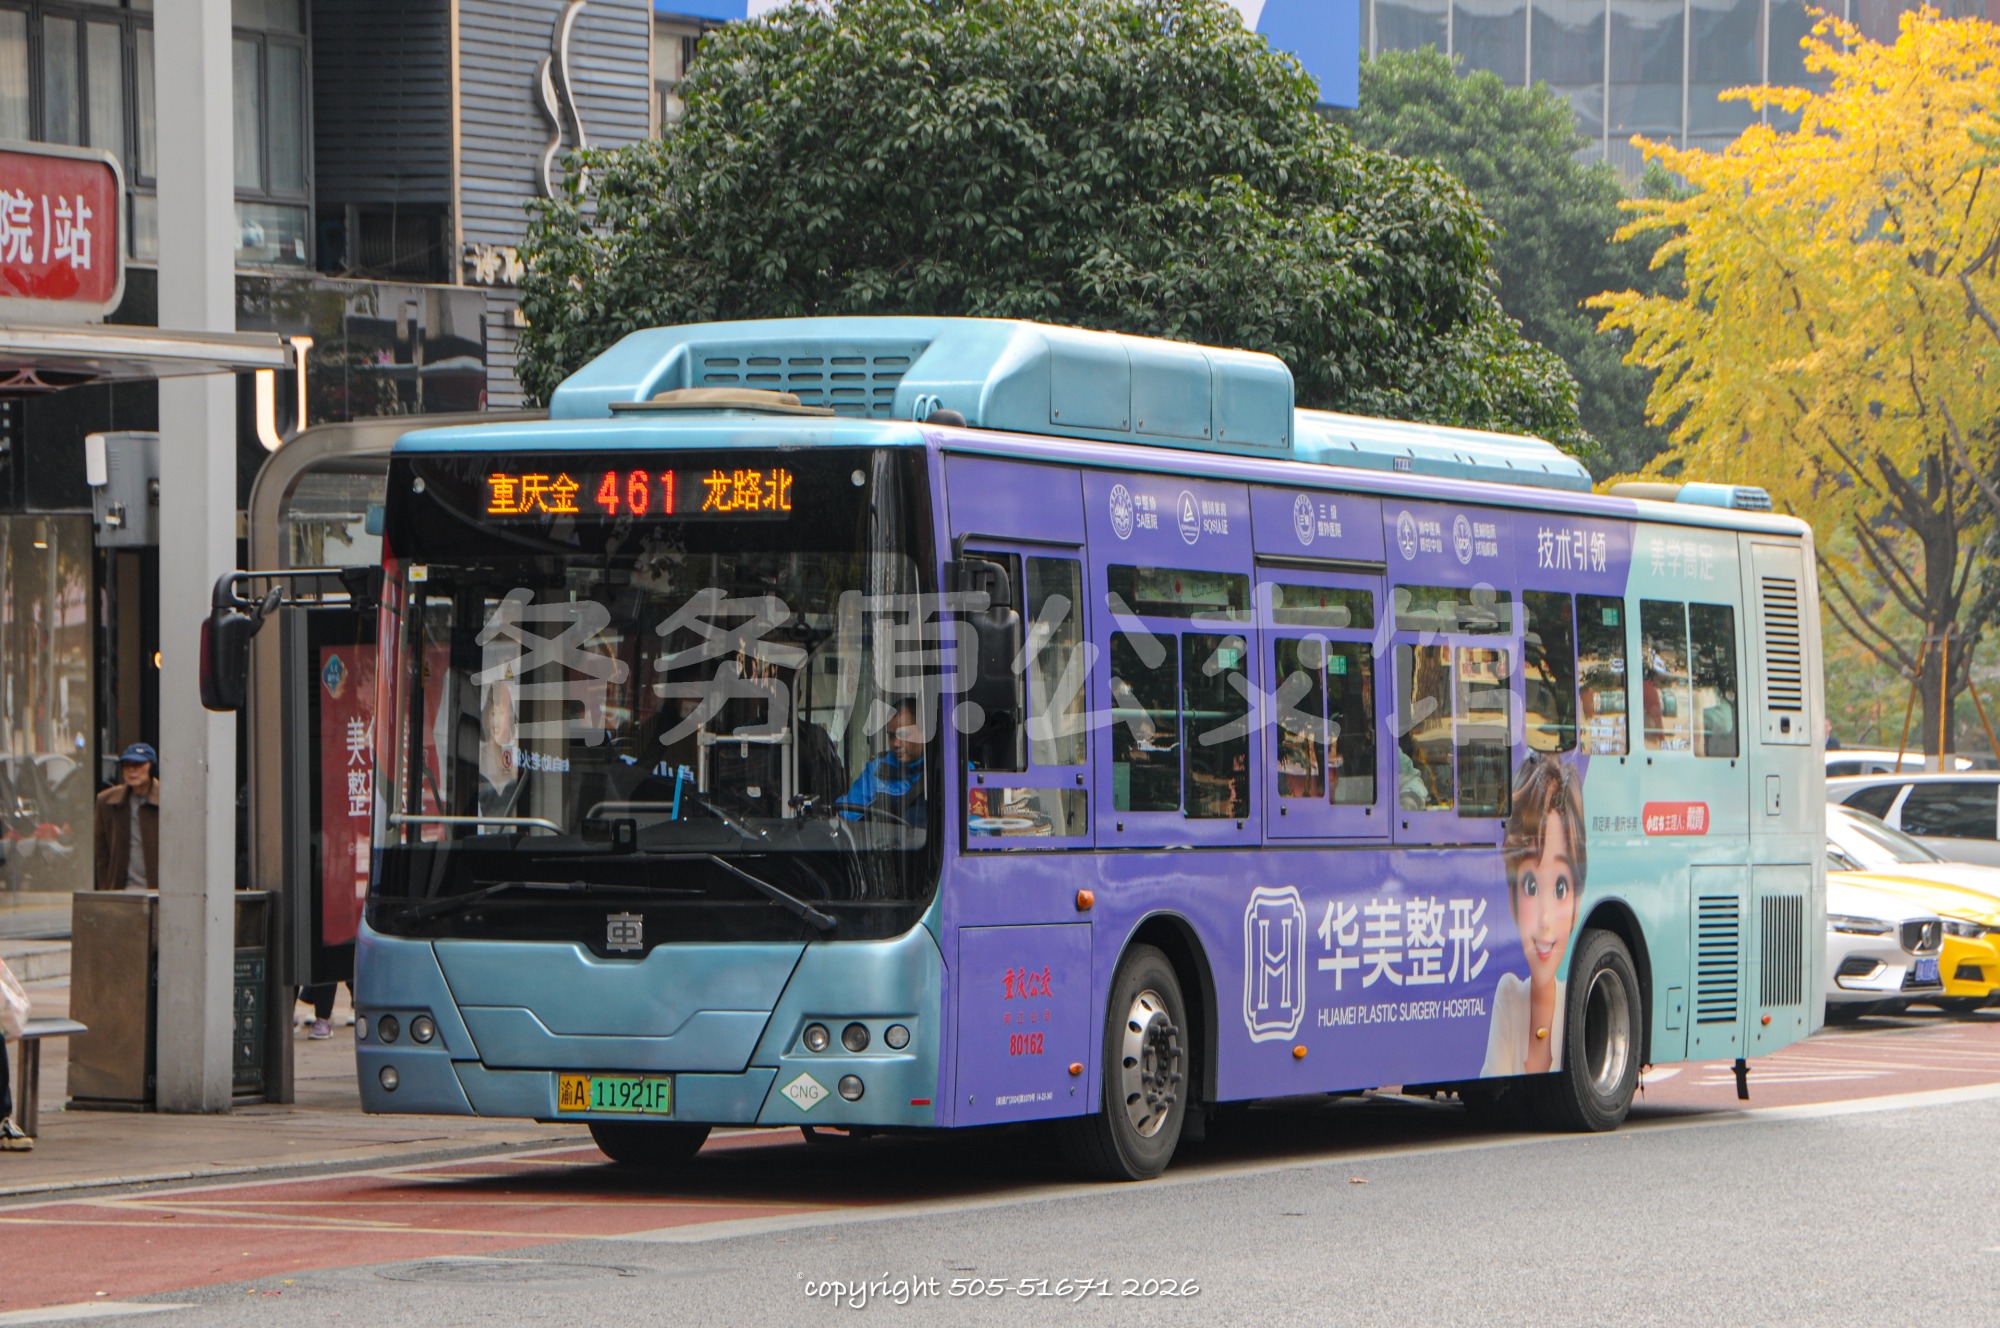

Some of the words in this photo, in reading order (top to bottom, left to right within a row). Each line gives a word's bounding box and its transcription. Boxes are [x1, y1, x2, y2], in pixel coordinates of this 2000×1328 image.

[487, 473, 580, 513] 重庆金
[596, 470, 674, 515] 461
[702, 468, 793, 511] 龙路北
[1538, 526, 1606, 573] 技术引领
[1650, 537, 1715, 581] 美学高定
[1317, 896, 1490, 991] 华美整形
[1002, 966, 1053, 1000] 重庆公交
[1317, 1005, 1357, 1027] HUAMEI
[1358, 1002, 1398, 1024] PLASTIC
[1399, 1000, 1442, 1021] SURGERY
[1442, 998, 1486, 1018] HOSPITAL
[1010, 1031, 1044, 1056] 80162
[790, 1085, 819, 1099] CNG
